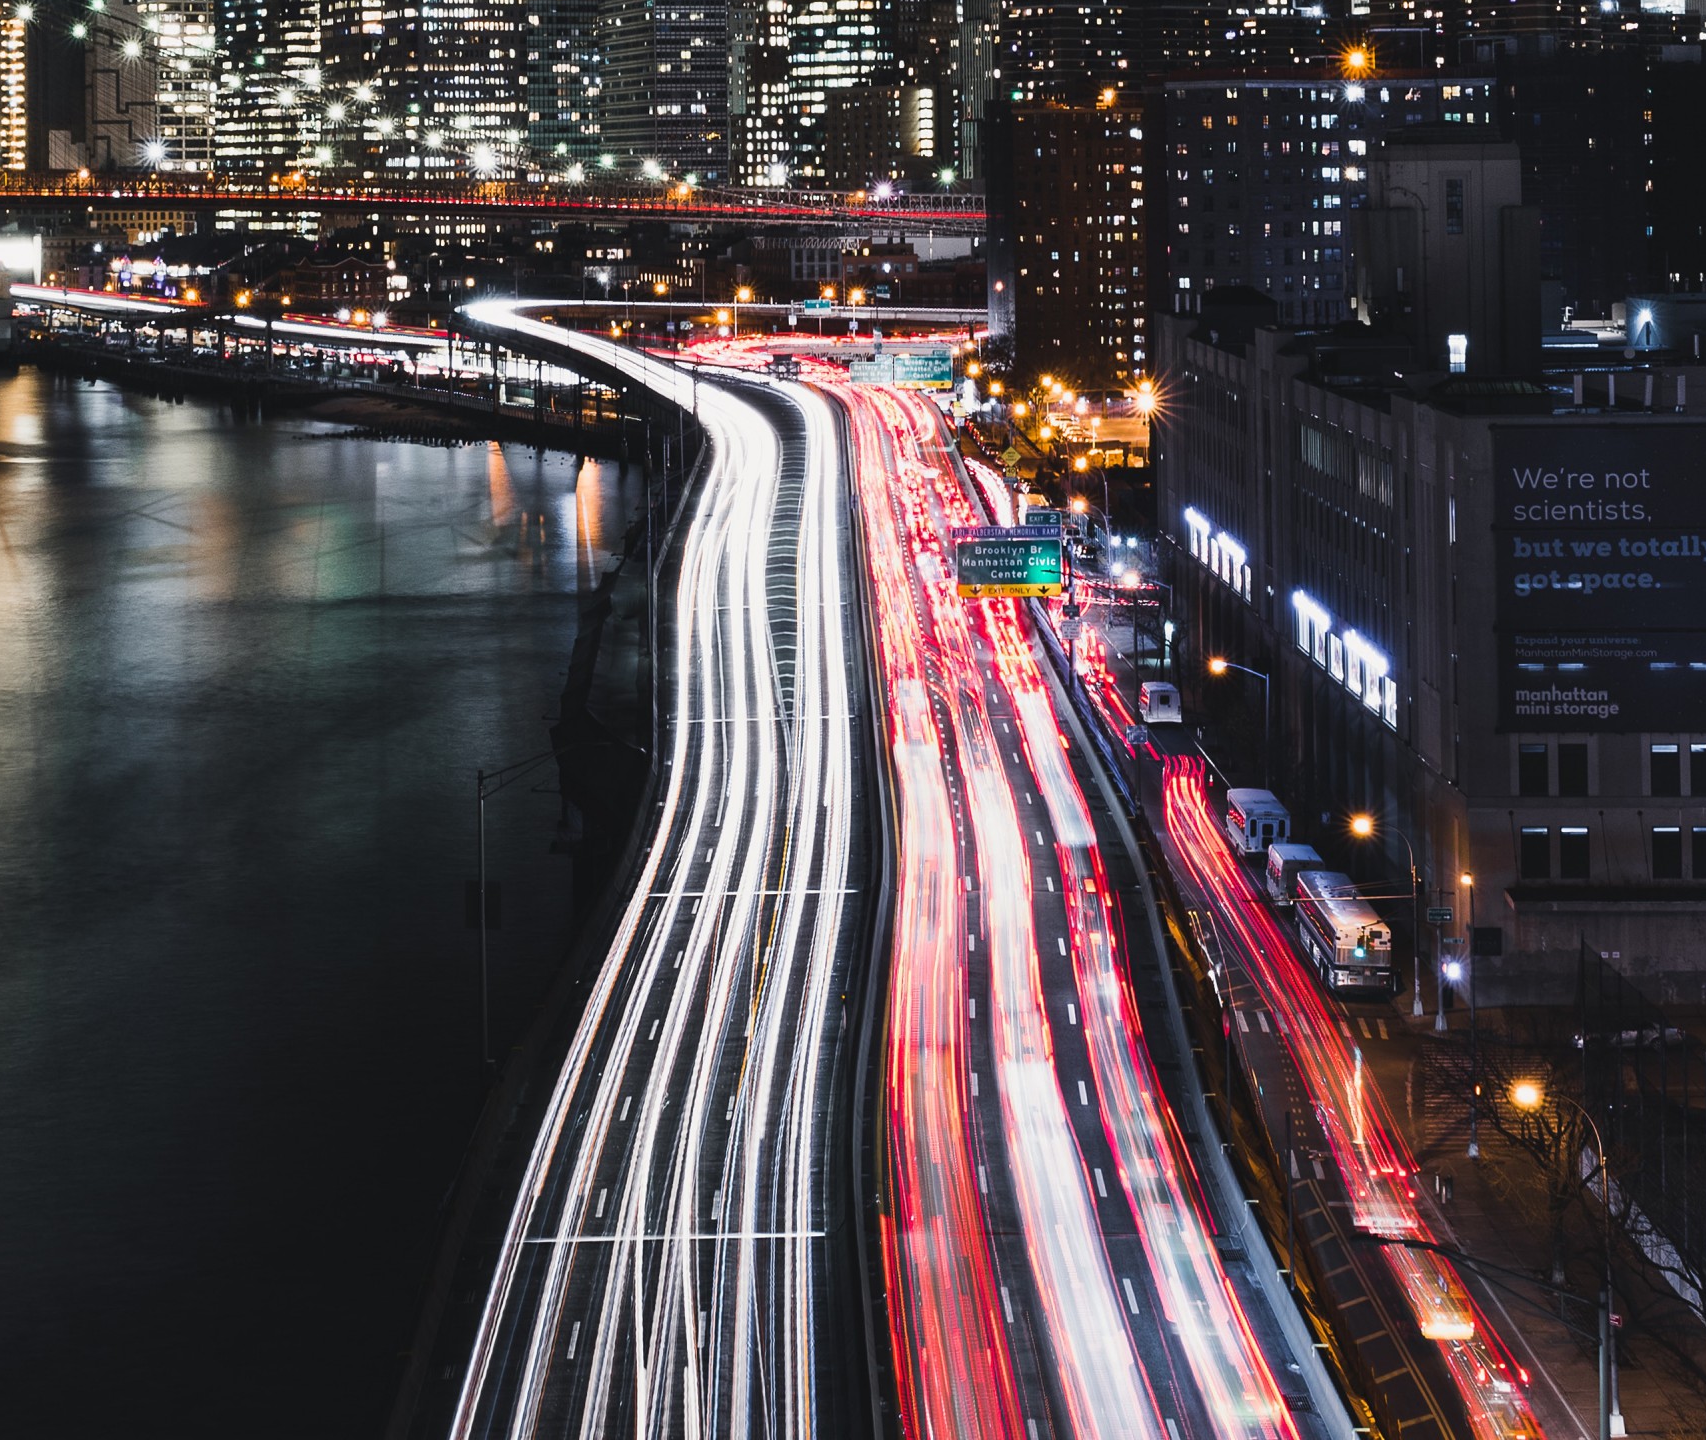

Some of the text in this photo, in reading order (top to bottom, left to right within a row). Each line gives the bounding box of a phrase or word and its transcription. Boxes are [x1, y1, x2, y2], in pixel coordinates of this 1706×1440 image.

[1512, 467, 1651, 489] We're not
[1513, 499, 1652, 523] scientists,
[1049, 514, 1057, 523] 2
[1009, 528, 1039, 536] MEMORIAL
[1042, 527, 1059, 536] RAMP
[975, 545, 1043, 556] Brooklyn Br
[1513, 536, 1565, 558] but
[1570, 541, 1612, 558] we
[962, 556, 1057, 567] Manhattan Civic
[990, 569, 1028, 579] Center
[1513, 570, 1662, 596] got space.
[1514, 635, 1558, 647] Expand
[1560, 637, 1587, 647] your
[1515, 647, 1658, 660] ManhattanMiniStorage.com
[1515, 682, 1609, 702] manhattan
[1515, 702, 1620, 719] mini storage
